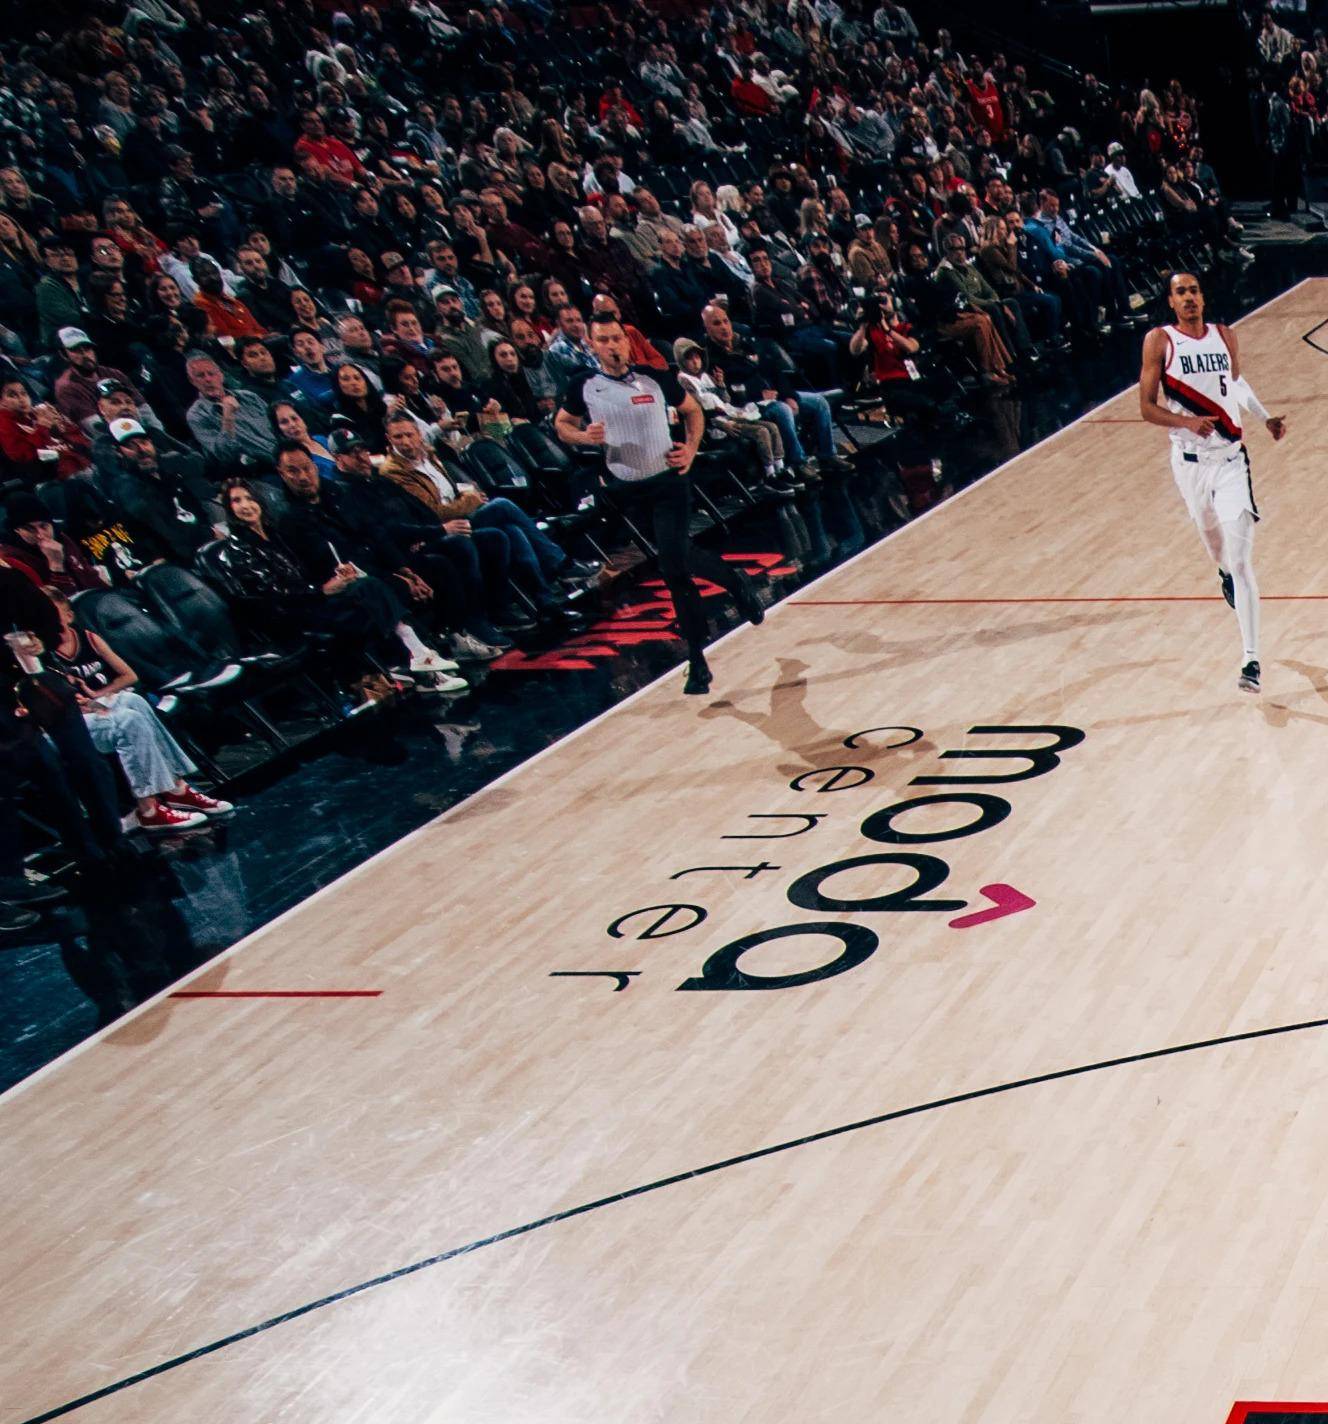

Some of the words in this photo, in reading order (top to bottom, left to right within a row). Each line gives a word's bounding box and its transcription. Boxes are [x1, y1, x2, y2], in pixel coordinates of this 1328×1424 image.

[1180, 353, 1230, 375] BLAZERS
[1219, 374, 1228, 398] 5
[548, 726, 924, 992] center
[673, 725, 1086, 991] moda
